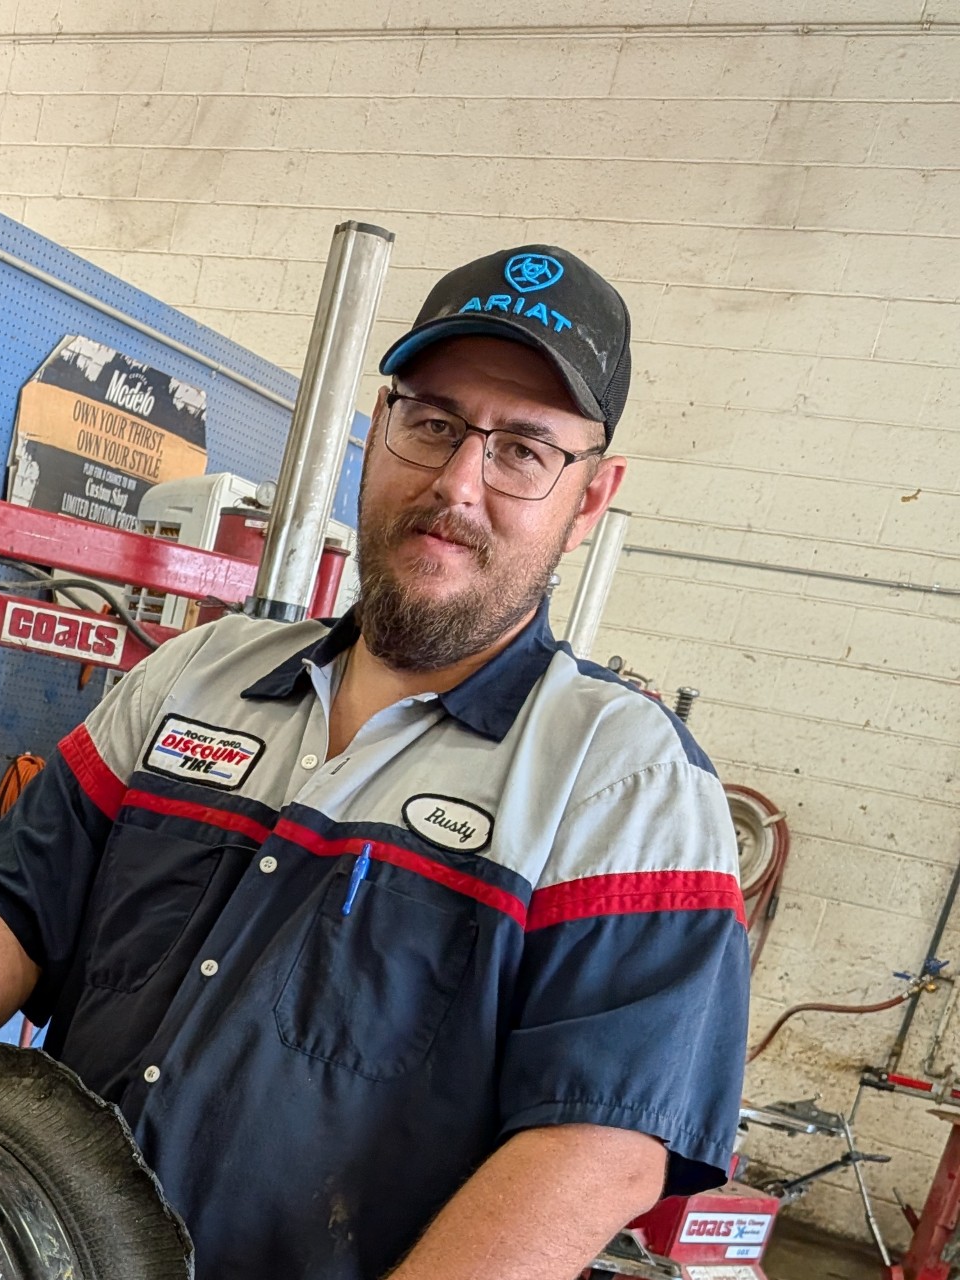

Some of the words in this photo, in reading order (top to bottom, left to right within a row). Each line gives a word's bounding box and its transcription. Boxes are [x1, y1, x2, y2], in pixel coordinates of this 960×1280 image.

[458, 294, 572, 333] ARIAT
[105, 370, 155, 418] Modelo
[73, 400, 100, 429] OWN
[100, 409, 128, 440] YOUR
[128, 420, 165, 458] THIRST,
[77, 429, 103, 458] OWN
[102, 437, 130, 468] YOUR
[129, 450, 162, 480] STYLE
[62, 493, 90, 518] LIMITED
[89, 502, 117, 529] EDITION
[85, 478, 112, 503] Custom
[110, 487, 129, 513] Shop
[161, 734, 251, 766] DISCOUNT
[183, 730, 216, 744] ROCKY
[217, 740, 242, 749] FORD
[179, 755, 218, 773] TIRE
[424, 807, 476, 843] Rusty
